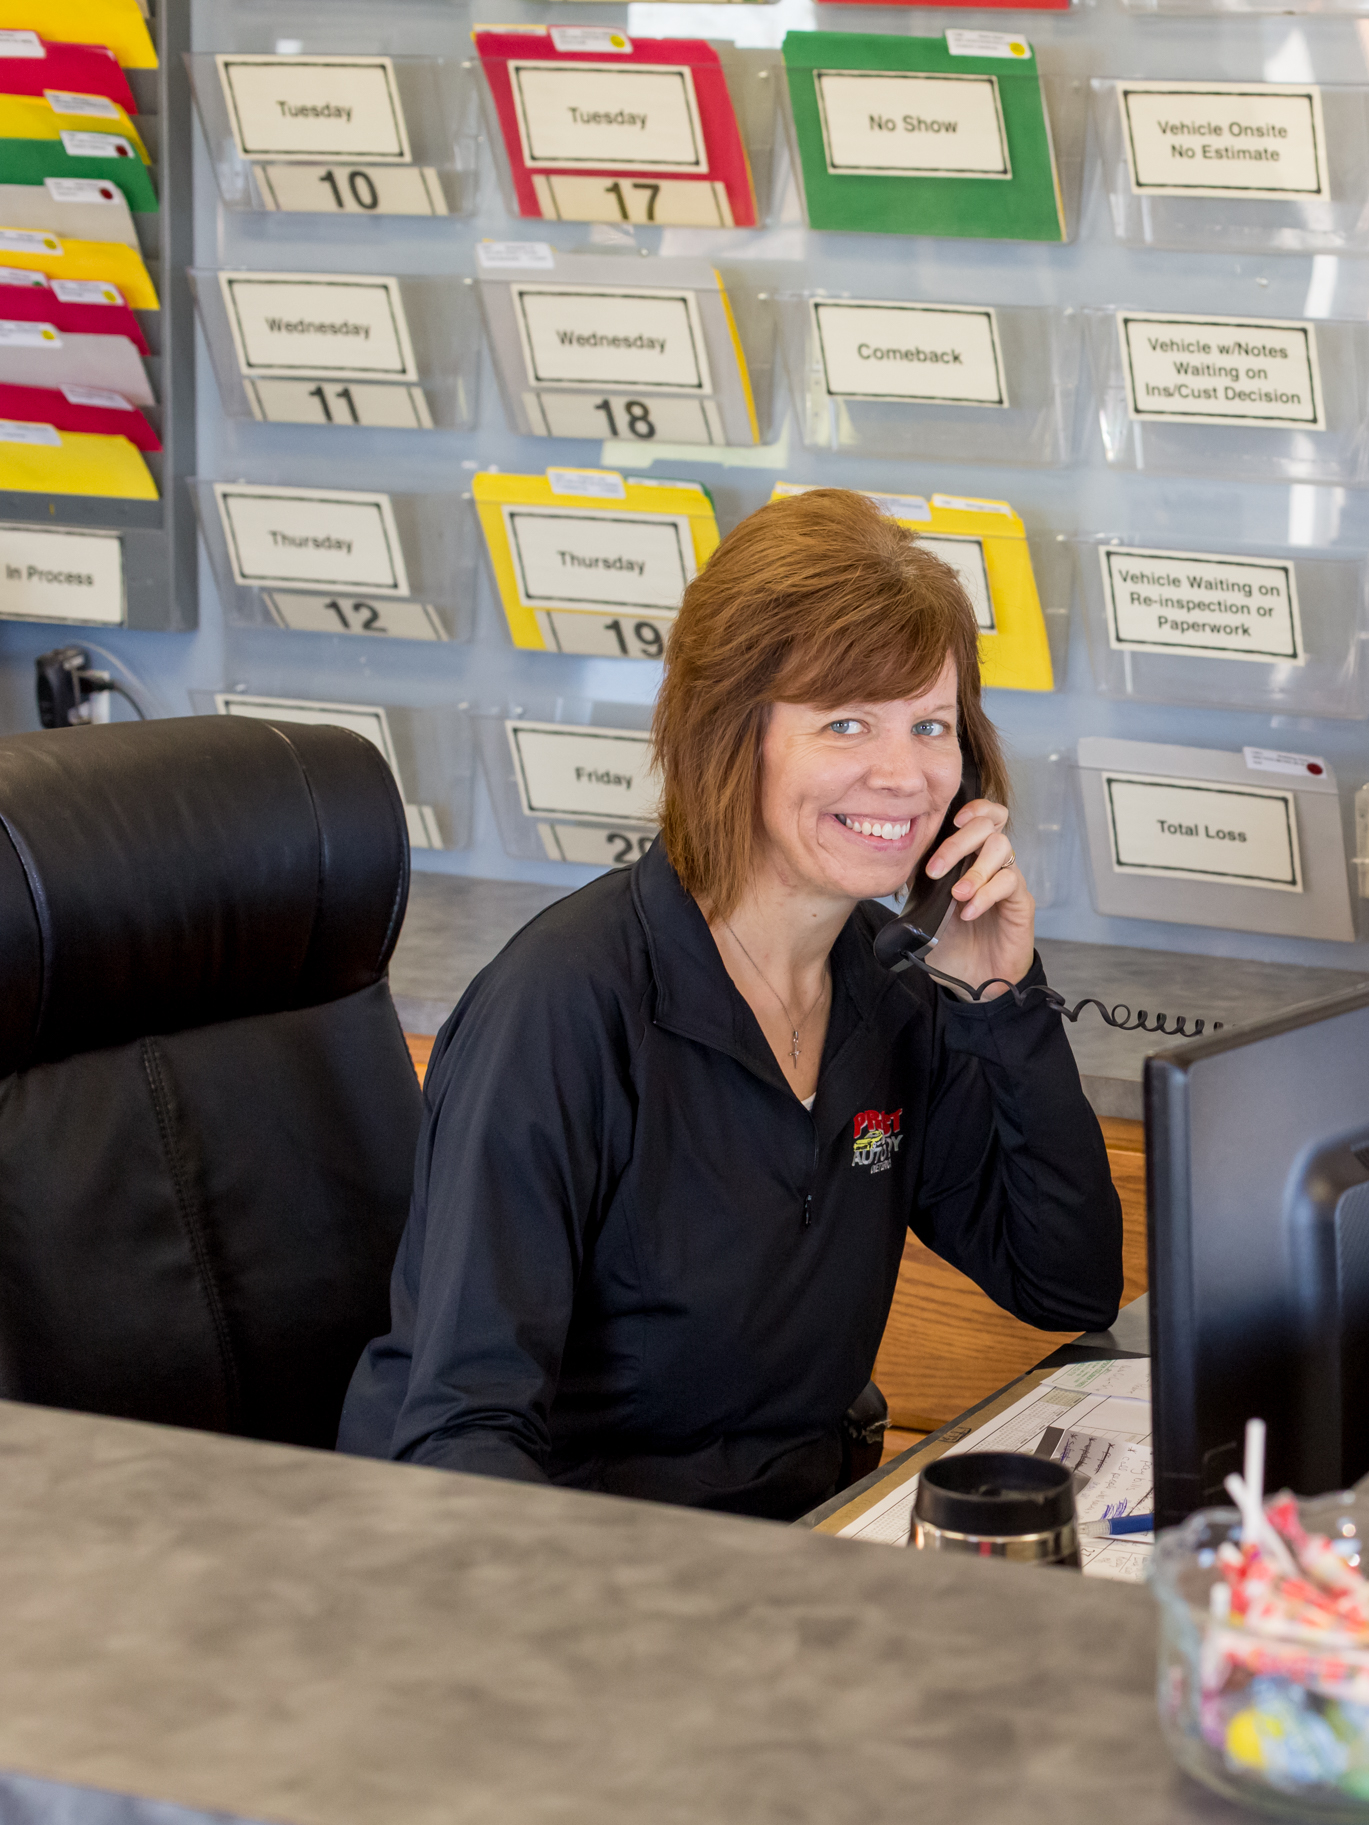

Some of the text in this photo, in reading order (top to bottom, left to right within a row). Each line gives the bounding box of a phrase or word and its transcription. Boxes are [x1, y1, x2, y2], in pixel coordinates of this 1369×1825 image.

[277, 100, 353, 124] Tuesday
[567, 106, 648, 130] Tuesday
[869, 113, 959, 135] No Show
[1157, 120, 1288, 139] Vehicle Onsite
[1171, 144, 1280, 162] No Estimate
[319, 168, 381, 211] 10
[604, 180, 662, 221] 17
[265, 315, 371, 341] Wednesday
[556, 328, 667, 355] Wednesday
[857, 342, 963, 365] Comeback
[1147, 337, 1289, 360] Vehicle w/Notes
[1174, 361, 1268, 382] Waiting on
[308, 385, 362, 424] 11
[1145, 382, 1301, 405] Ins/Cust Decision
[594, 398, 657, 440] 18
[270, 529, 353, 555] Thursday
[5, 564, 95, 586] In Process
[557, 550, 646, 576] Thursday
[1118, 569, 1281, 598] Vehicle Waiting on
[324, 600, 388, 634] 12
[1130, 591, 1274, 618] Re-inspection or
[603, 617, 664, 659] 19
[1157, 616, 1252, 637] Paperwork
[574, 766, 633, 791] Friday
[1157, 819, 1247, 843] Total Loss
